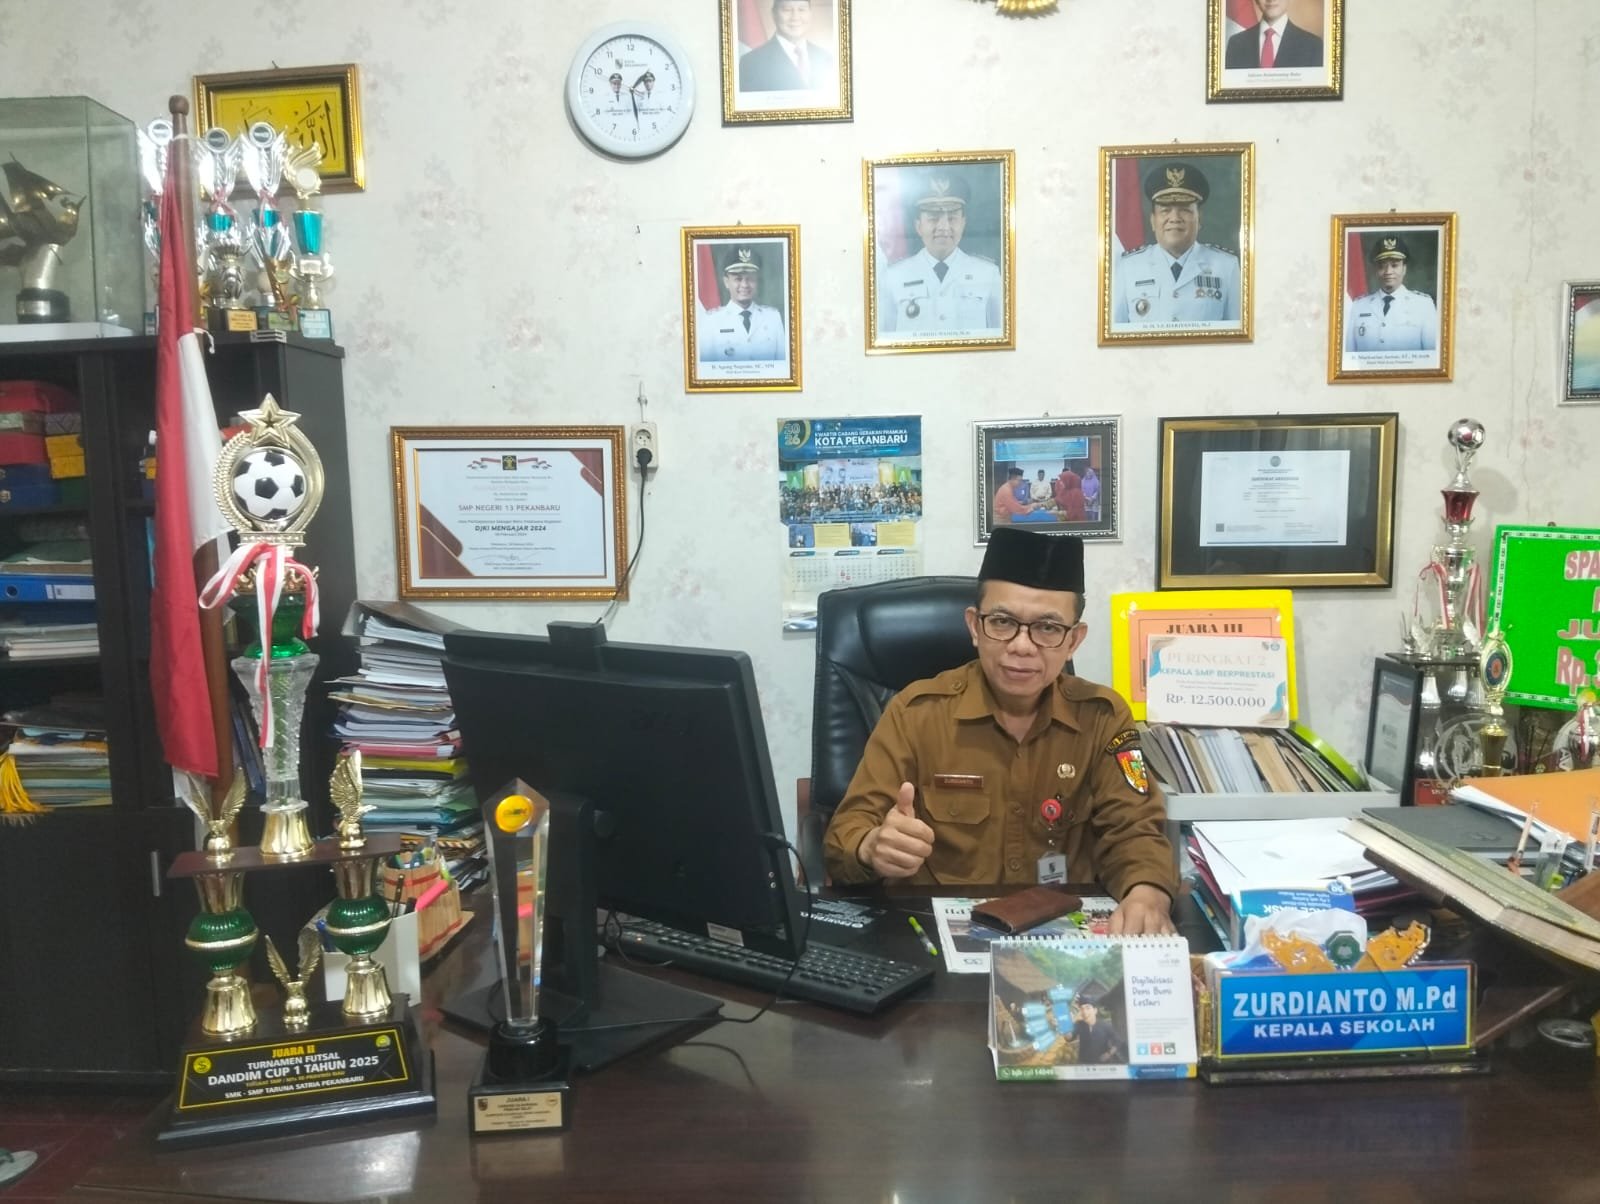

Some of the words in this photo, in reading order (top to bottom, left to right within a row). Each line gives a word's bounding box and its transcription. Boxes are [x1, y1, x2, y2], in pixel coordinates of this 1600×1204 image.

[815, 437, 843, 446] KOTA
[846, 434, 908, 445] PEKANBARU
[1166, 624, 1218, 633] JUARA
[1223, 623, 1243, 633] III
[1167, 652, 1252, 665] PERINGKAT
[1255, 655, 1266, 666] 2
[1160, 668, 1192, 676] KEPALA
[1195, 668, 1215, 676] SMP
[1217, 670, 1275, 679] BERPRESTASI
[1191, 695, 1266, 708] 12.500.000
[1132, 976, 1173, 987] Digitalisasi
[1132, 987, 1150, 995] Demi
[1153, 986, 1172, 995] Bumi
[1133, 998, 1160, 1007] Lestari
[1232, 988, 1387, 1018] ZURDIANTO
[1396, 985, 1456, 1011] M.Pd
[1254, 1022, 1334, 1038] KEPALA
[1340, 1018, 1435, 1034] SEKOLAH
[272, 1046, 304, 1058] JUARA
[306, 1045, 316, 1054] II
[248, 1056, 303, 1070] TURNAMEN
[305, 1052, 340, 1063] FUTSAL
[208, 1070, 262, 1086] DANDIM
[264, 1066, 290, 1079] CUP
[294, 1066, 300, 1075] 1
[304, 1060, 346, 1074] TAHUN
[350, 1056, 380, 1068] 2025
[266, 1085, 294, 1093] TARUNA
[296, 1081, 320, 1090] SATRIA
[322, 1076, 364, 1086] PEKANBARU
